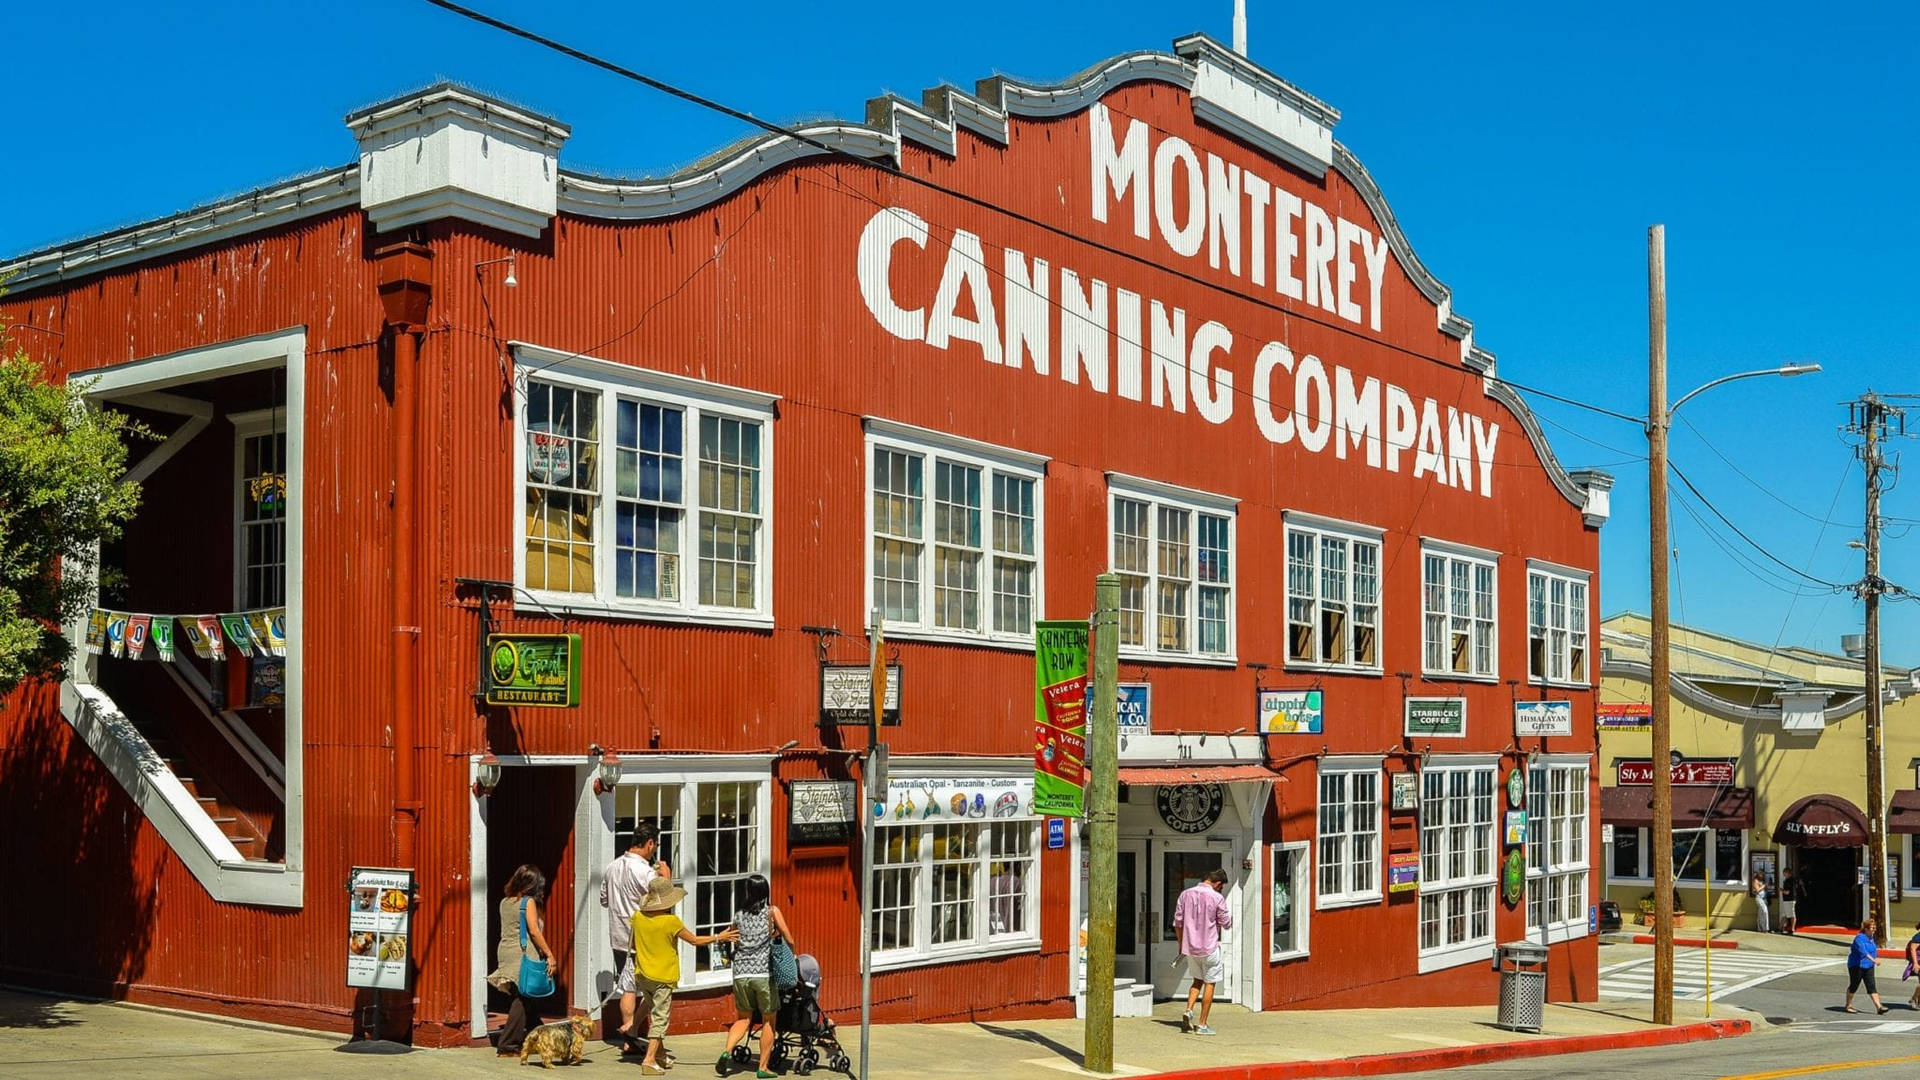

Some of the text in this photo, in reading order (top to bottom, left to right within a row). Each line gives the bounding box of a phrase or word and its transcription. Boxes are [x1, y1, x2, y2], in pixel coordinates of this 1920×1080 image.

[1089, 101, 1388, 332] MONTEREY
[858, 207, 1500, 499] CANNING COMPANY
[1040, 630, 1087, 649] CANNERY
[1051, 653, 1075, 671] ROW
[497, 690, 560, 702] RESTAURANT
[1088, 699, 1141, 713] AICAN
[1520, 715, 1567, 723] HIMALAYAN
[1178, 744, 1192, 759] 711
[1621, 768, 1639, 781] Sly
[889, 780, 928, 789] Australian
[929, 780, 946, 789] Opal
[991, 779, 1017, 787] Custom
[1050, 825, 1063, 834] ATM
[1166, 814, 1214, 833] COFFEE
[1786, 822, 1801, 833] SLY
